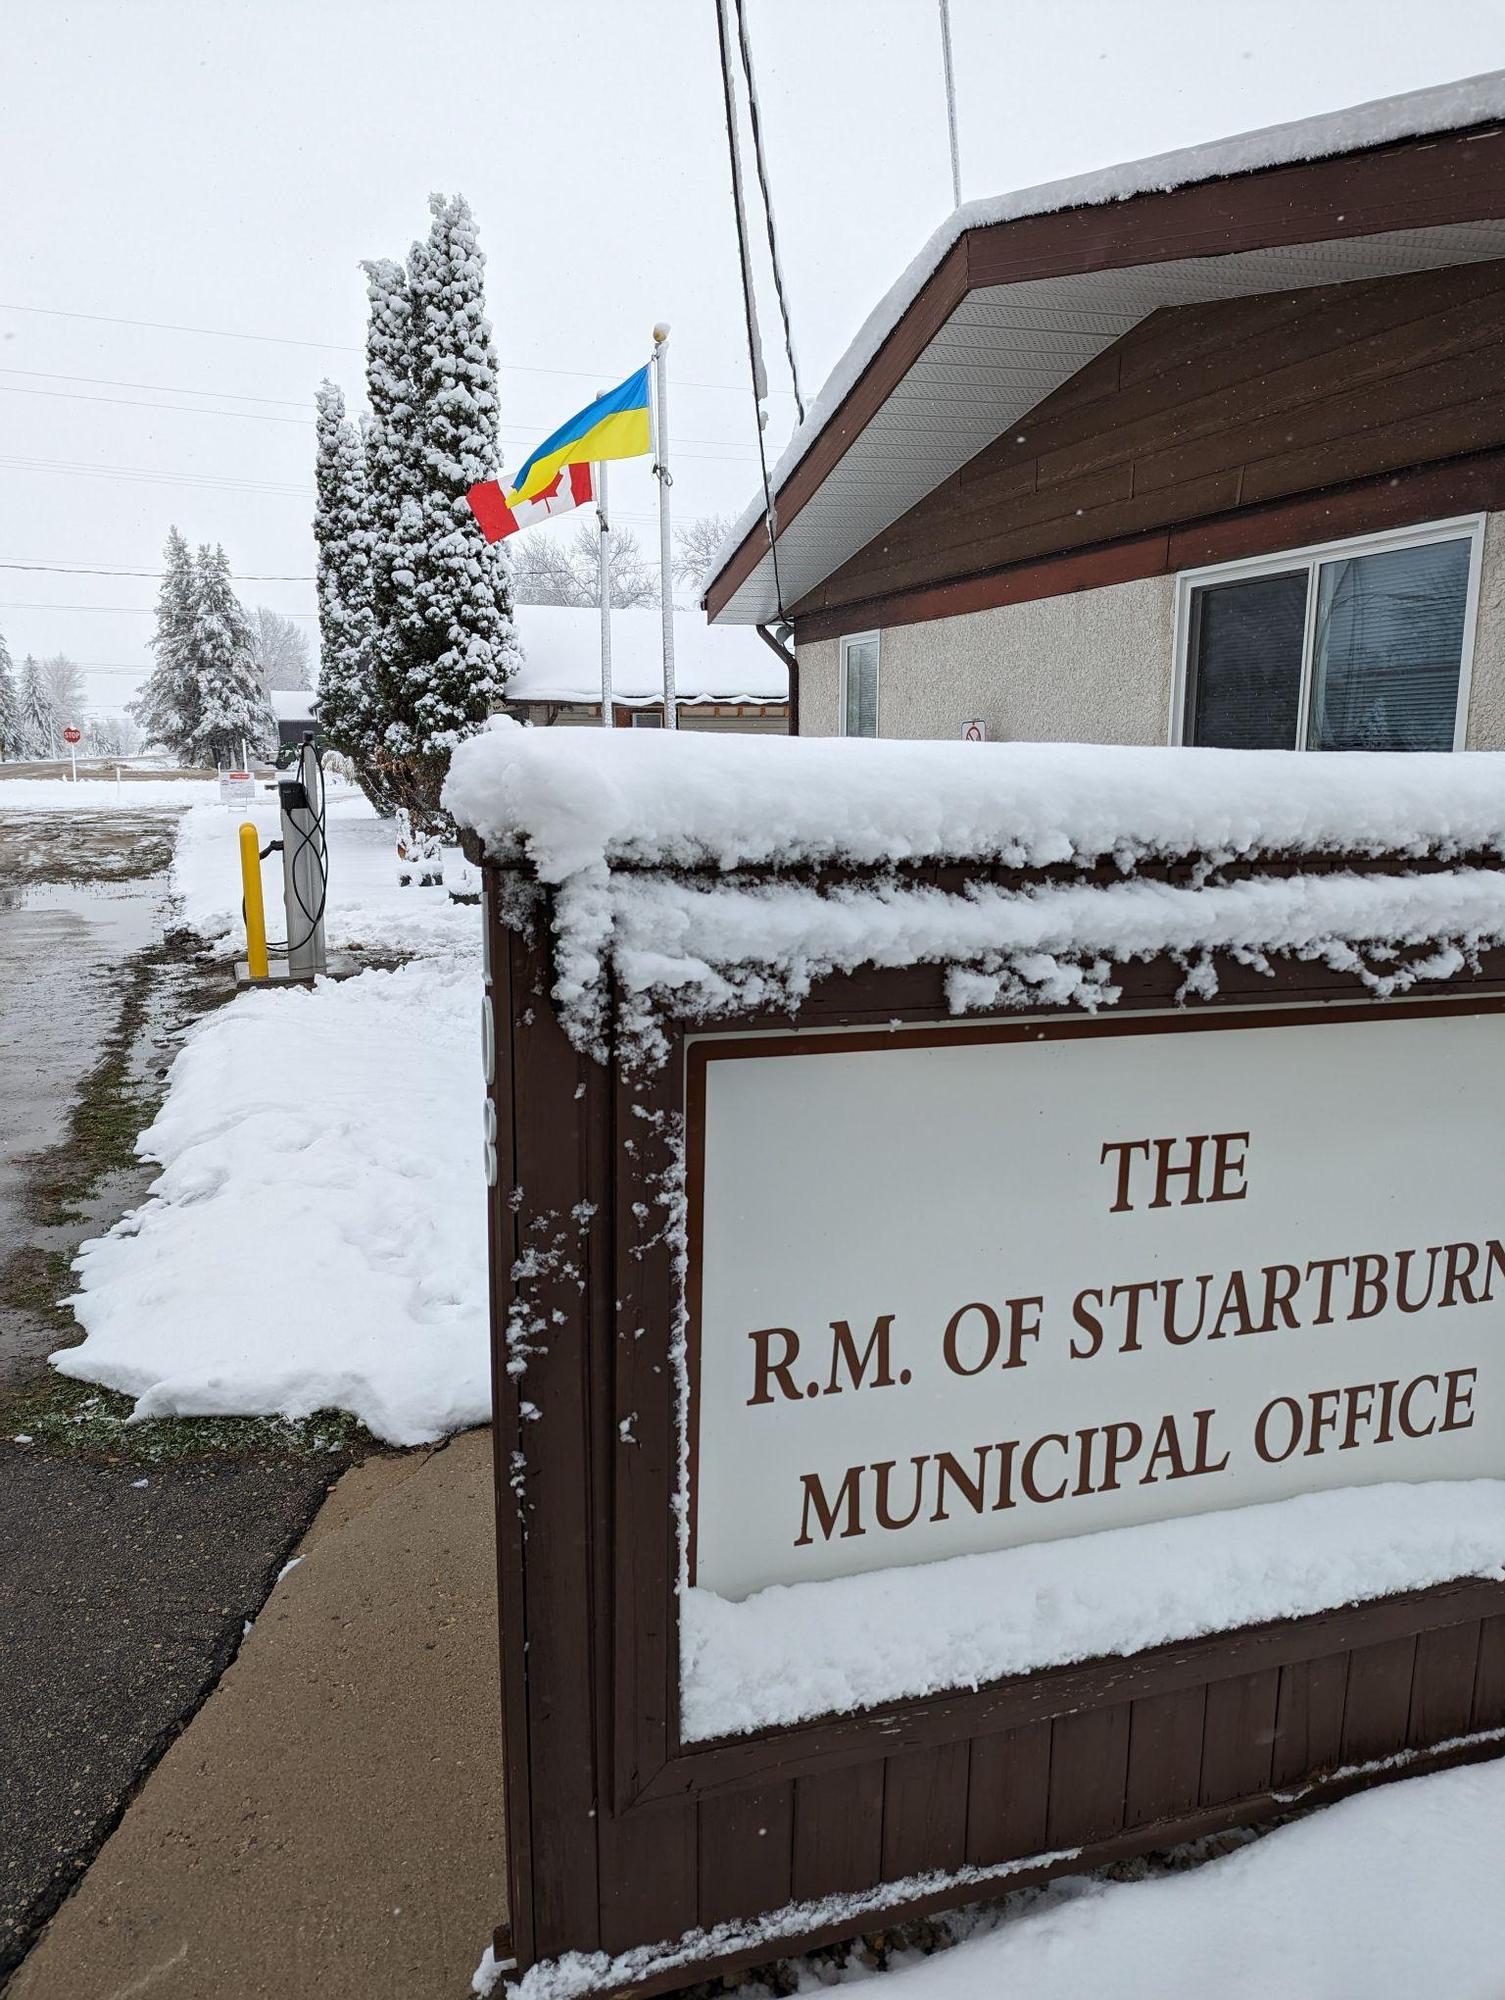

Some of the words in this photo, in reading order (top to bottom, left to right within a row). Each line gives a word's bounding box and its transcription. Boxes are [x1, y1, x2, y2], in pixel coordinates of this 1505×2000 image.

[64, 731, 80, 739] STOP
[1099, 1131, 1250, 1214] THE
[746, 1314, 912, 1407] R.M.
[942, 1295, 1044, 1377] OF
[793, 1408, 1231, 1547] MUNICIPAL
[1254, 1367, 1478, 1464] OFFICE
